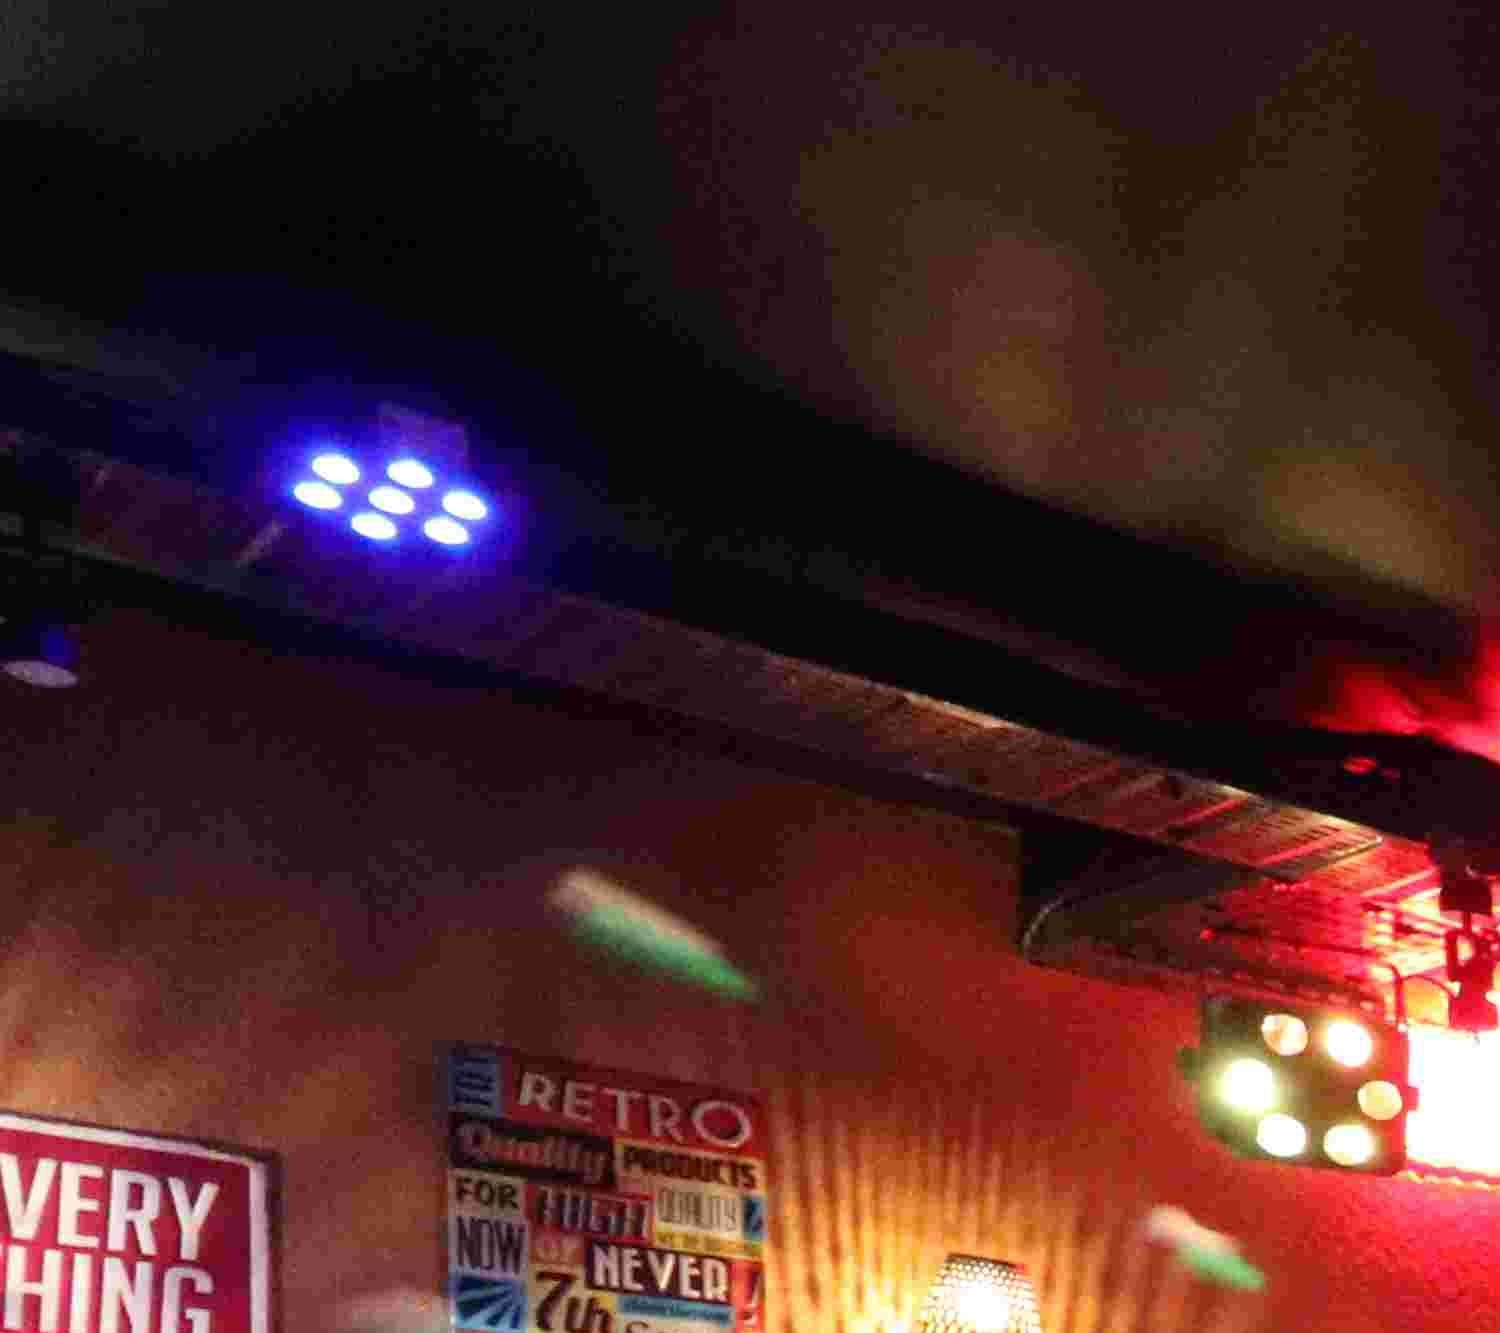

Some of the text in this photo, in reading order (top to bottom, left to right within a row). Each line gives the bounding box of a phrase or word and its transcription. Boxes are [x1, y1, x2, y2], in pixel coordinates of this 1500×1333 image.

[519, 1072, 751, 1149] RETRO
[455, 1176, 518, 1210] FOR
[457, 1216, 526, 1275] NOW
[592, 1243, 729, 1303] NEVER
